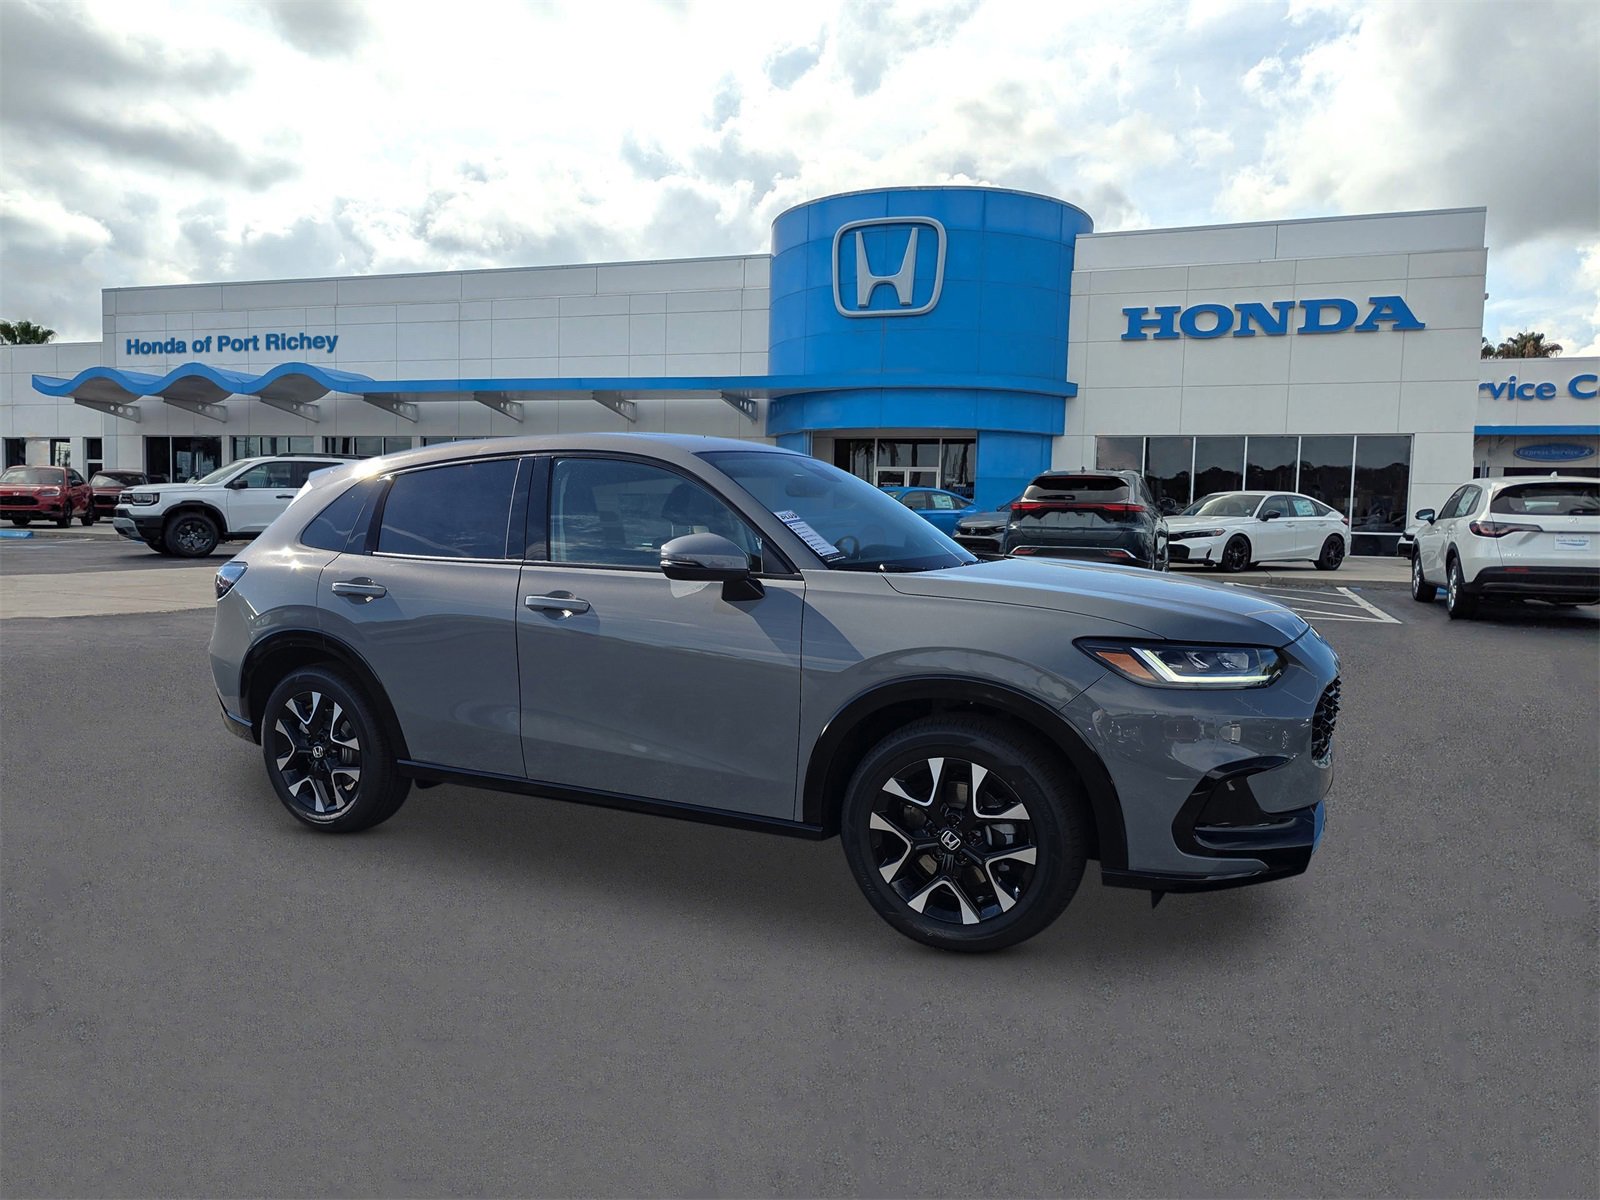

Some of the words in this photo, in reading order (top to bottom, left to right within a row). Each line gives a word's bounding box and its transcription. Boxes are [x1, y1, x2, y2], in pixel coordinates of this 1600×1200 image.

[1121, 295, 1426, 340] HONDA
[126, 338, 187, 355] Honda
[192, 336, 212, 353] of
[217, 335, 259, 353] Port
[265, 332, 339, 353] Richey
[1567, 373, 1600, 400] C
